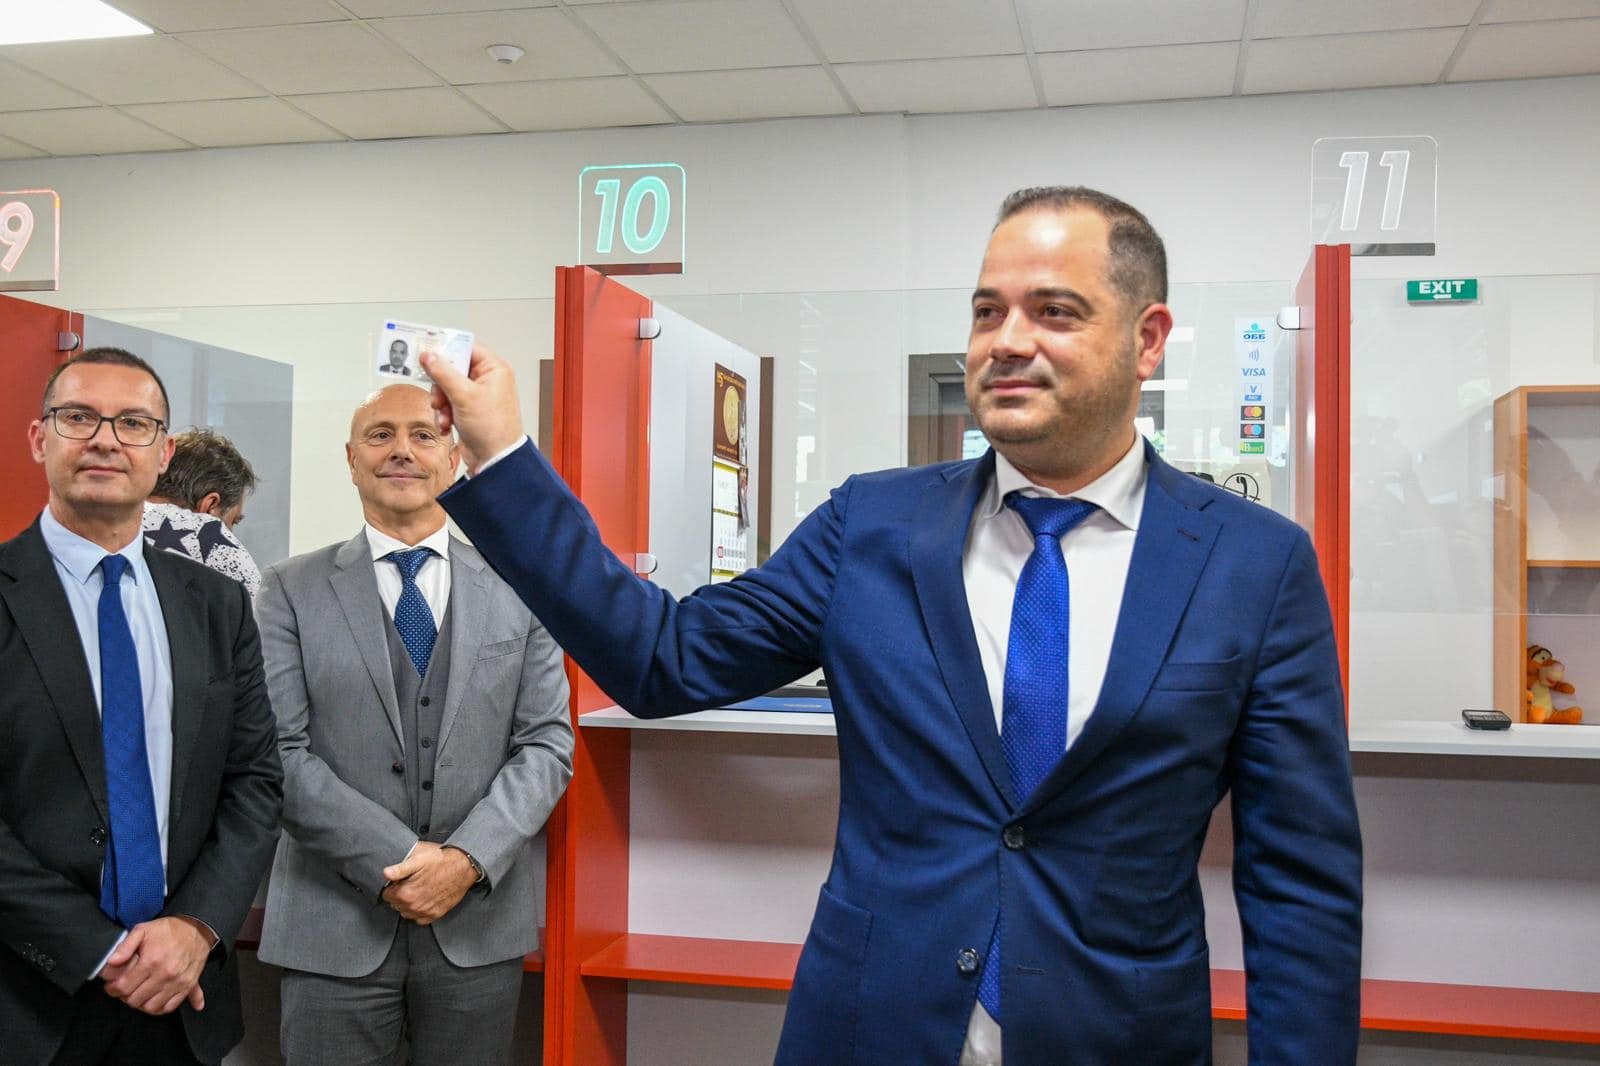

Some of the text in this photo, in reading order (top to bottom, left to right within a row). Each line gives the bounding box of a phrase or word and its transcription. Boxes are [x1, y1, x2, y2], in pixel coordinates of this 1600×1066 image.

[594, 175, 671, 254] 10
[1339, 150, 1410, 231] 11
[0, 201, 34, 273] 9
[1419, 280, 1465, 294] EXIT
[1242, 367, 1266, 377] VISA
